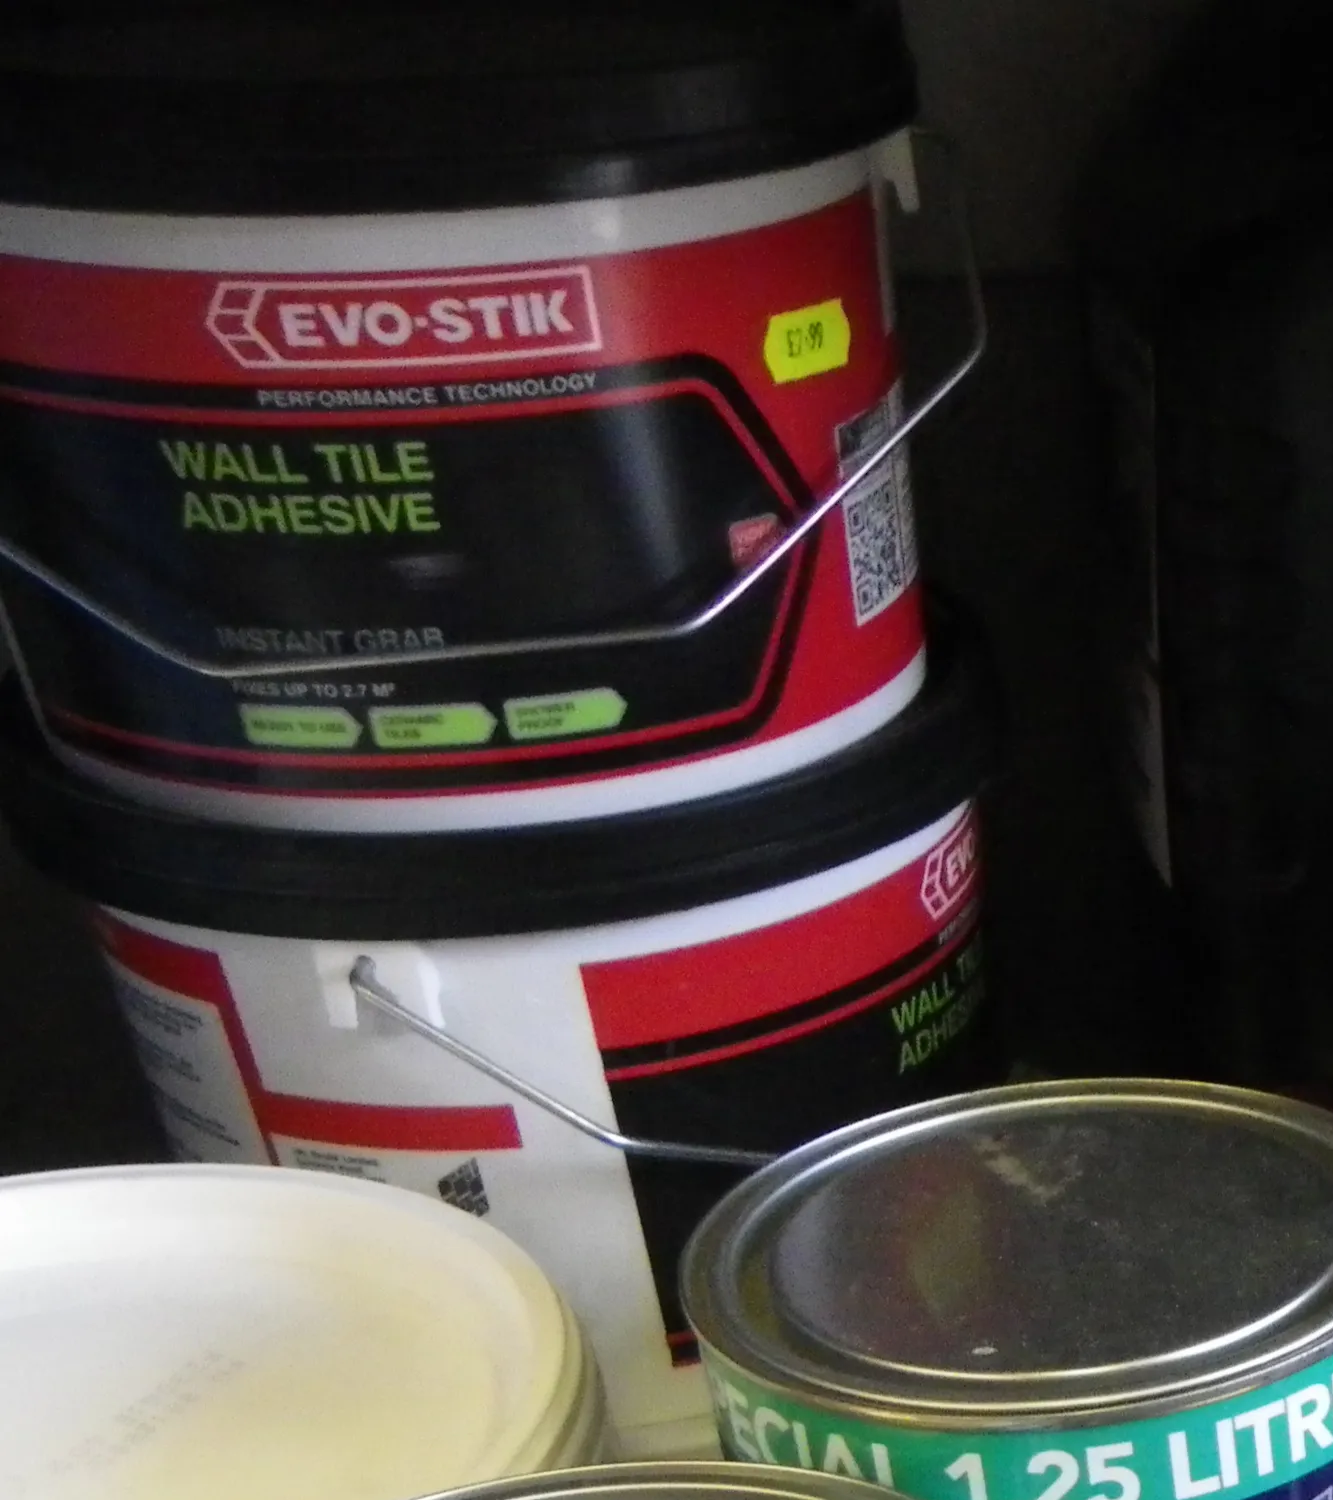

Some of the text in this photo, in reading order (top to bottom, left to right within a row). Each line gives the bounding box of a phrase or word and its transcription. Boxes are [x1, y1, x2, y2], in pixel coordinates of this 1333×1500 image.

[276, 289, 575, 347] EVO-STIK
[256, 372, 598, 409] PERFORMANCE TECHNOLOGY
[157, 439, 435, 484] WALL TILE
[183, 490, 441, 535] ADHESIVE
[215, 626, 445, 655] INSTANT GRAB
[283, 682, 309, 699] UP
[314, 682, 339, 700] TO
